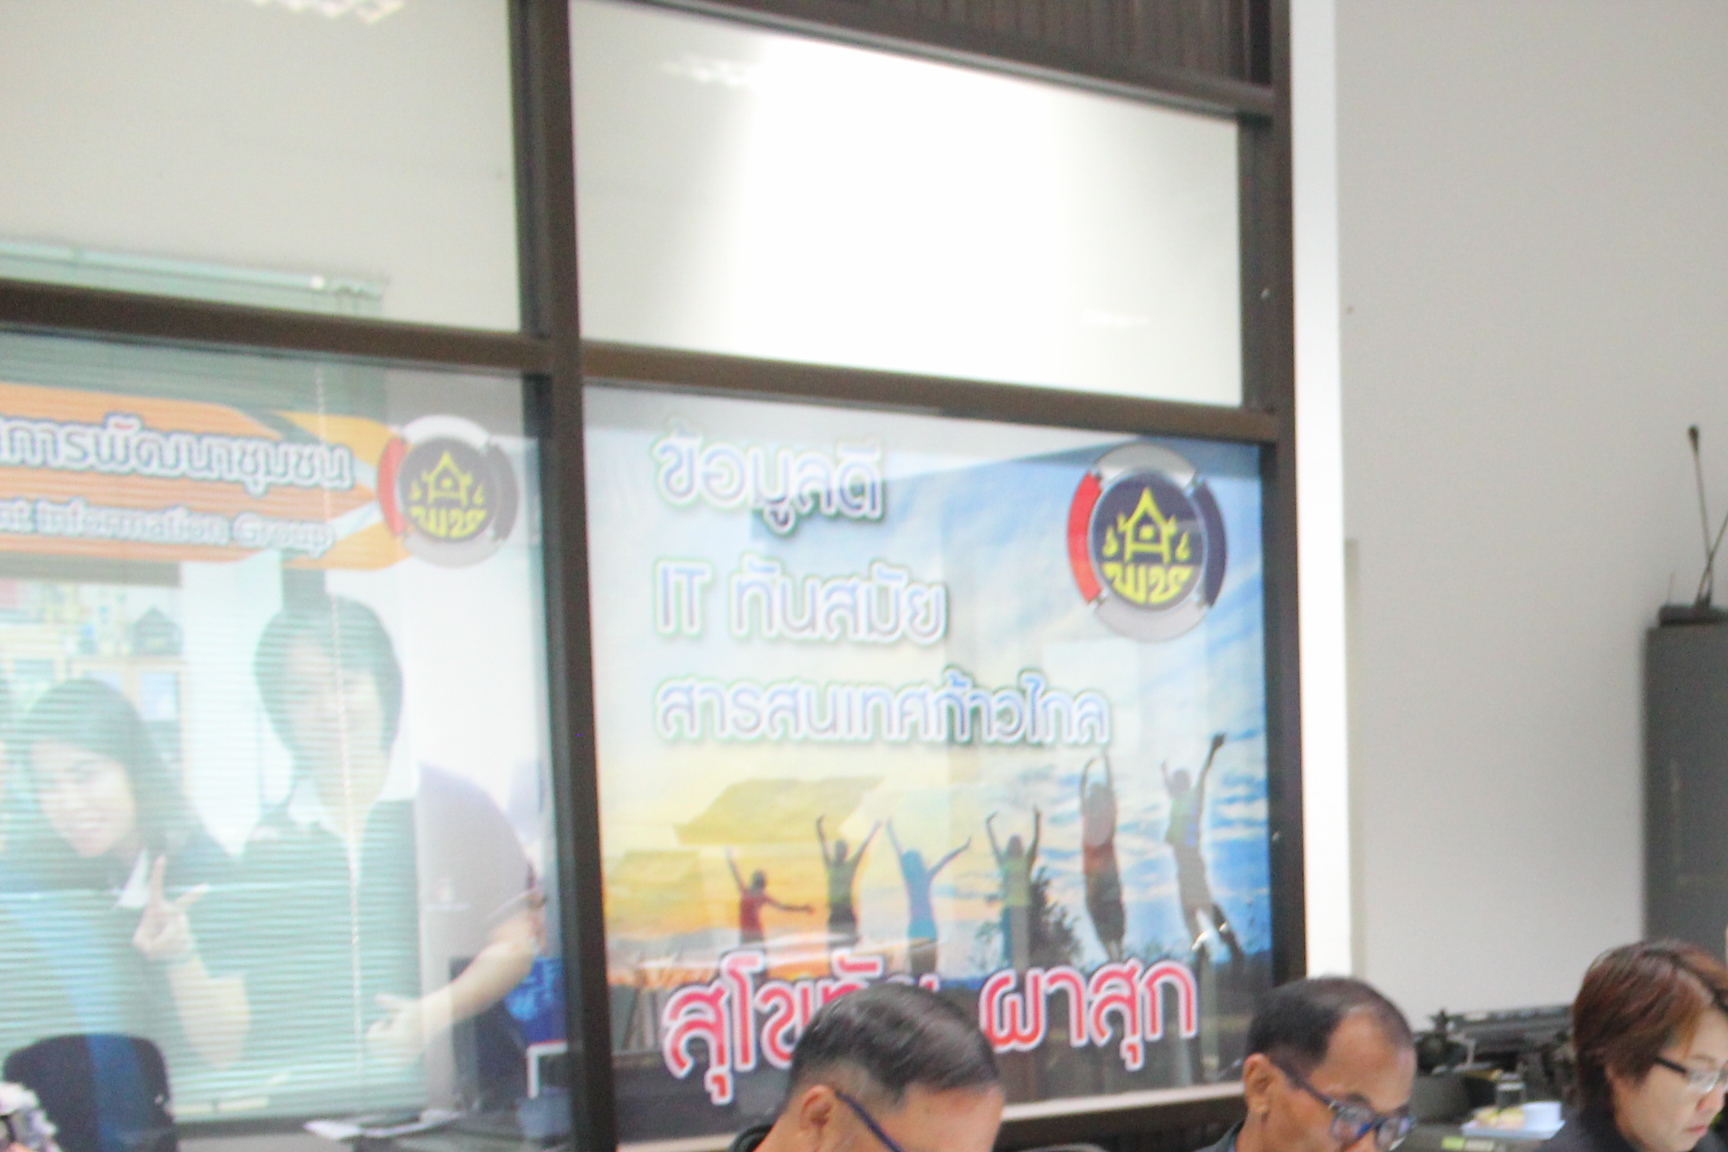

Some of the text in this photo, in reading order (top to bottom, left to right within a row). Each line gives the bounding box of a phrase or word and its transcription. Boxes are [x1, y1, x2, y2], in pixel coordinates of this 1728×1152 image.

[0, 415, 352, 494] การพัฒนาชุมชน
[658, 425, 882, 530] ข้อมูลดี
[232, 513, 336, 557] Group
[655, 553, 948, 645] IT ทันสมัย
[656, 666, 1112, 743] สารสนเทศก้าวไกล
[978, 957, 1199, 1070] ผาสุก
